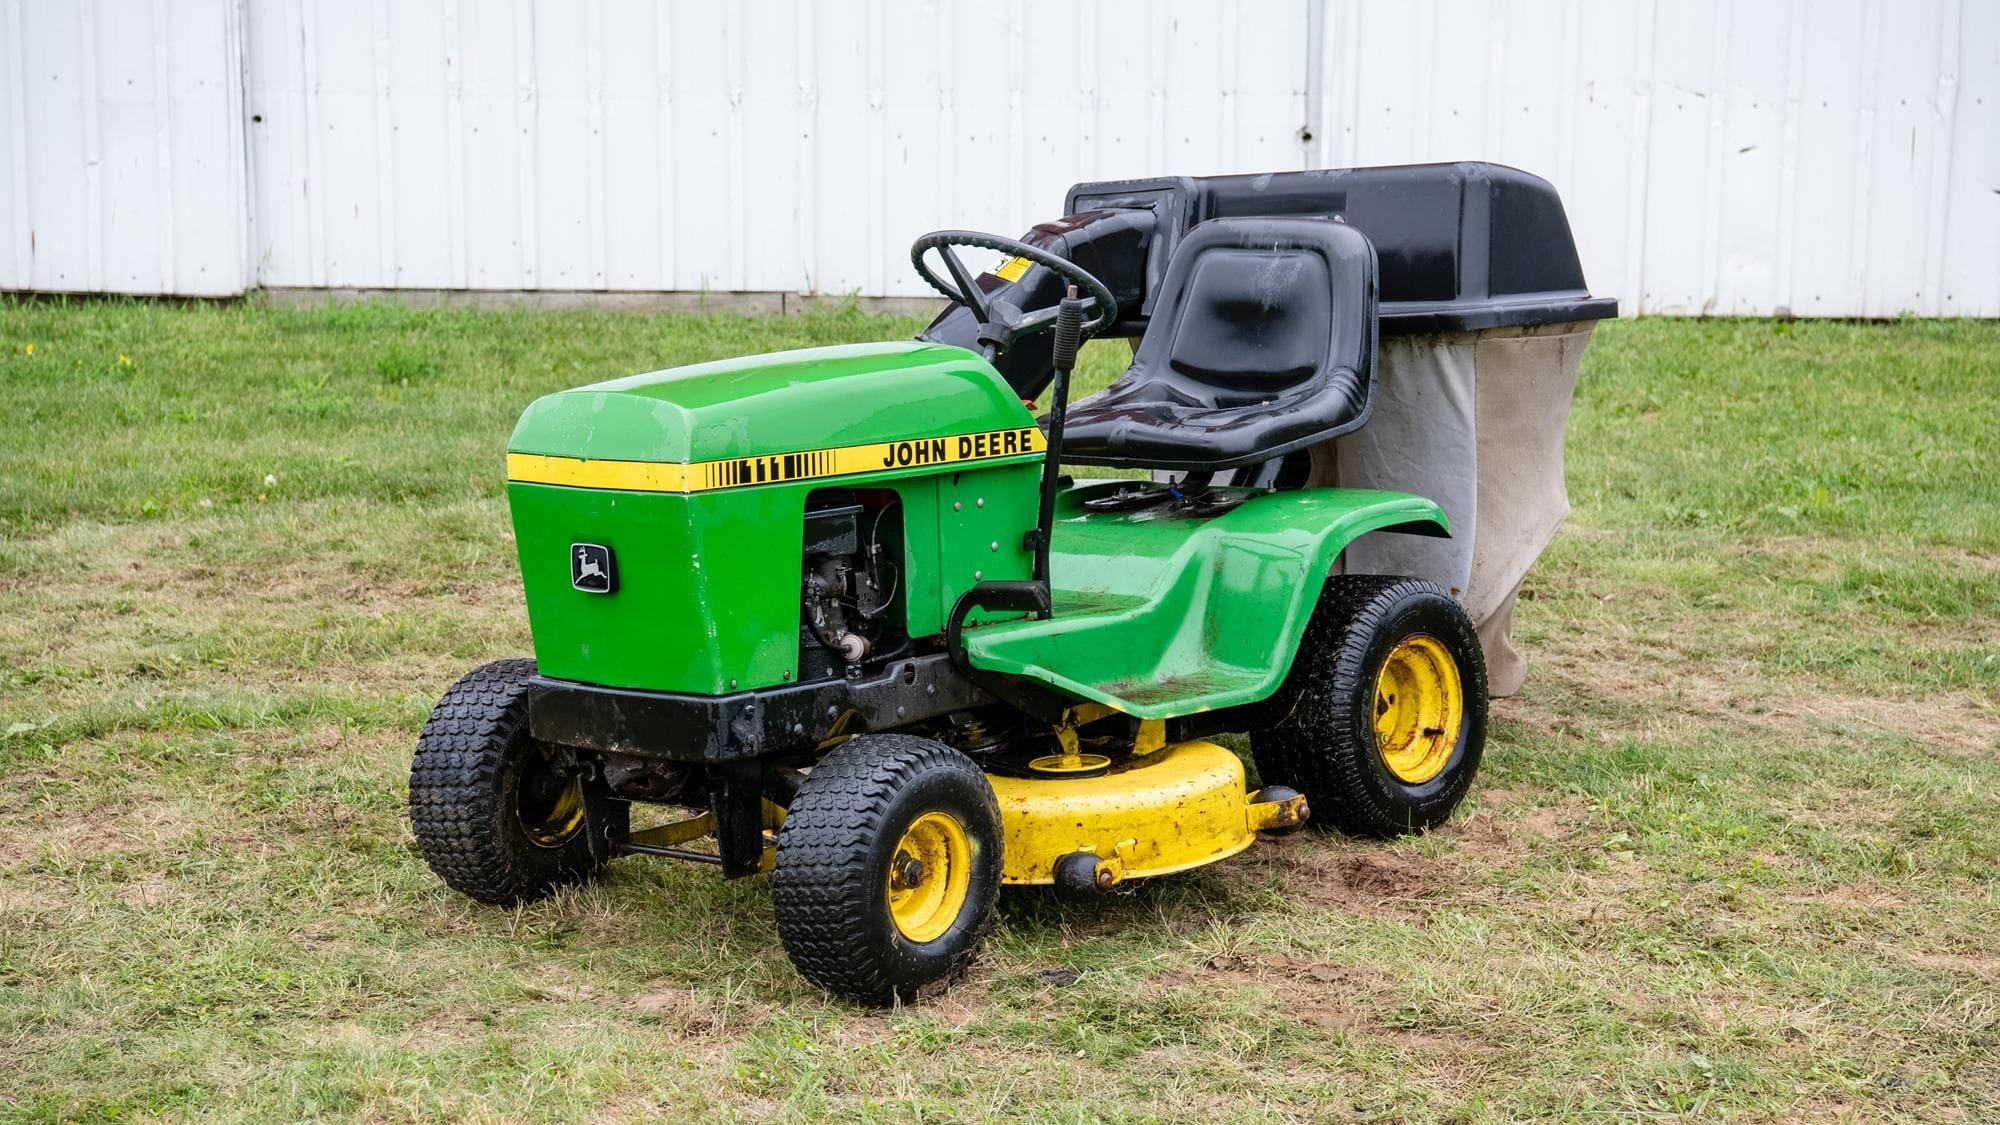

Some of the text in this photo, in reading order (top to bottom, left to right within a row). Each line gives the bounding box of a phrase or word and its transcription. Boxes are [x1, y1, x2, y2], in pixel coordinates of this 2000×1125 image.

[883, 429, 1032, 468] JOHN DEERE
[744, 455, 786, 484] 111
